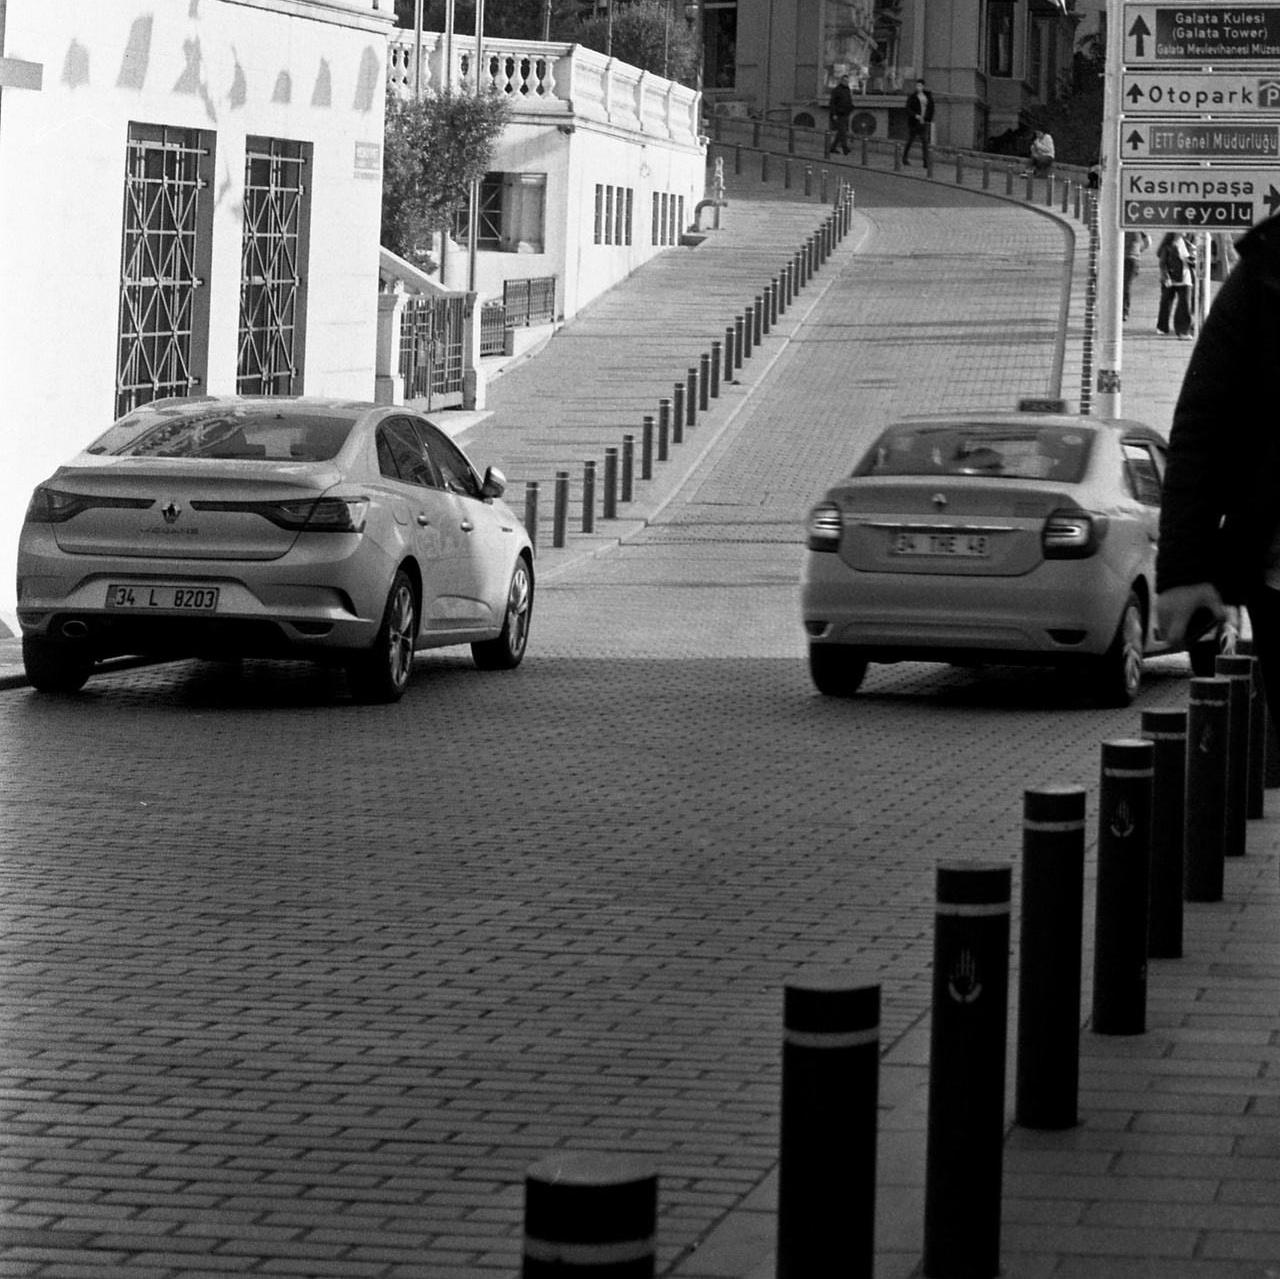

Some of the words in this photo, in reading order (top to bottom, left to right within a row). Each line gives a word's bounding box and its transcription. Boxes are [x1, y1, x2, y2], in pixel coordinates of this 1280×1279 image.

[1175, 12, 1218, 24] Galata
[1223, 12, 1265, 24] Kulesi
[1172, 27, 1219, 41] (Galata
[1223, 27, 1268, 41] Tower)
[1157, 43, 1184, 55] Galata
[1187, 43, 1249, 55] Mevlevihanesi
[1149, 86, 1253, 108] Otopark
[1150, 127, 1174, 149] İETT
[1178, 132, 1209, 150] Genel
[1213, 131, 1278, 154] Müdürlüğü
[1130, 176, 1254, 198] Kasımpaşa
[1127, 202, 1251, 223] Çevreyolu
[116, 588, 135, 605] 34
[149, 589, 158, 607] L
[174, 589, 215, 608] 8203
